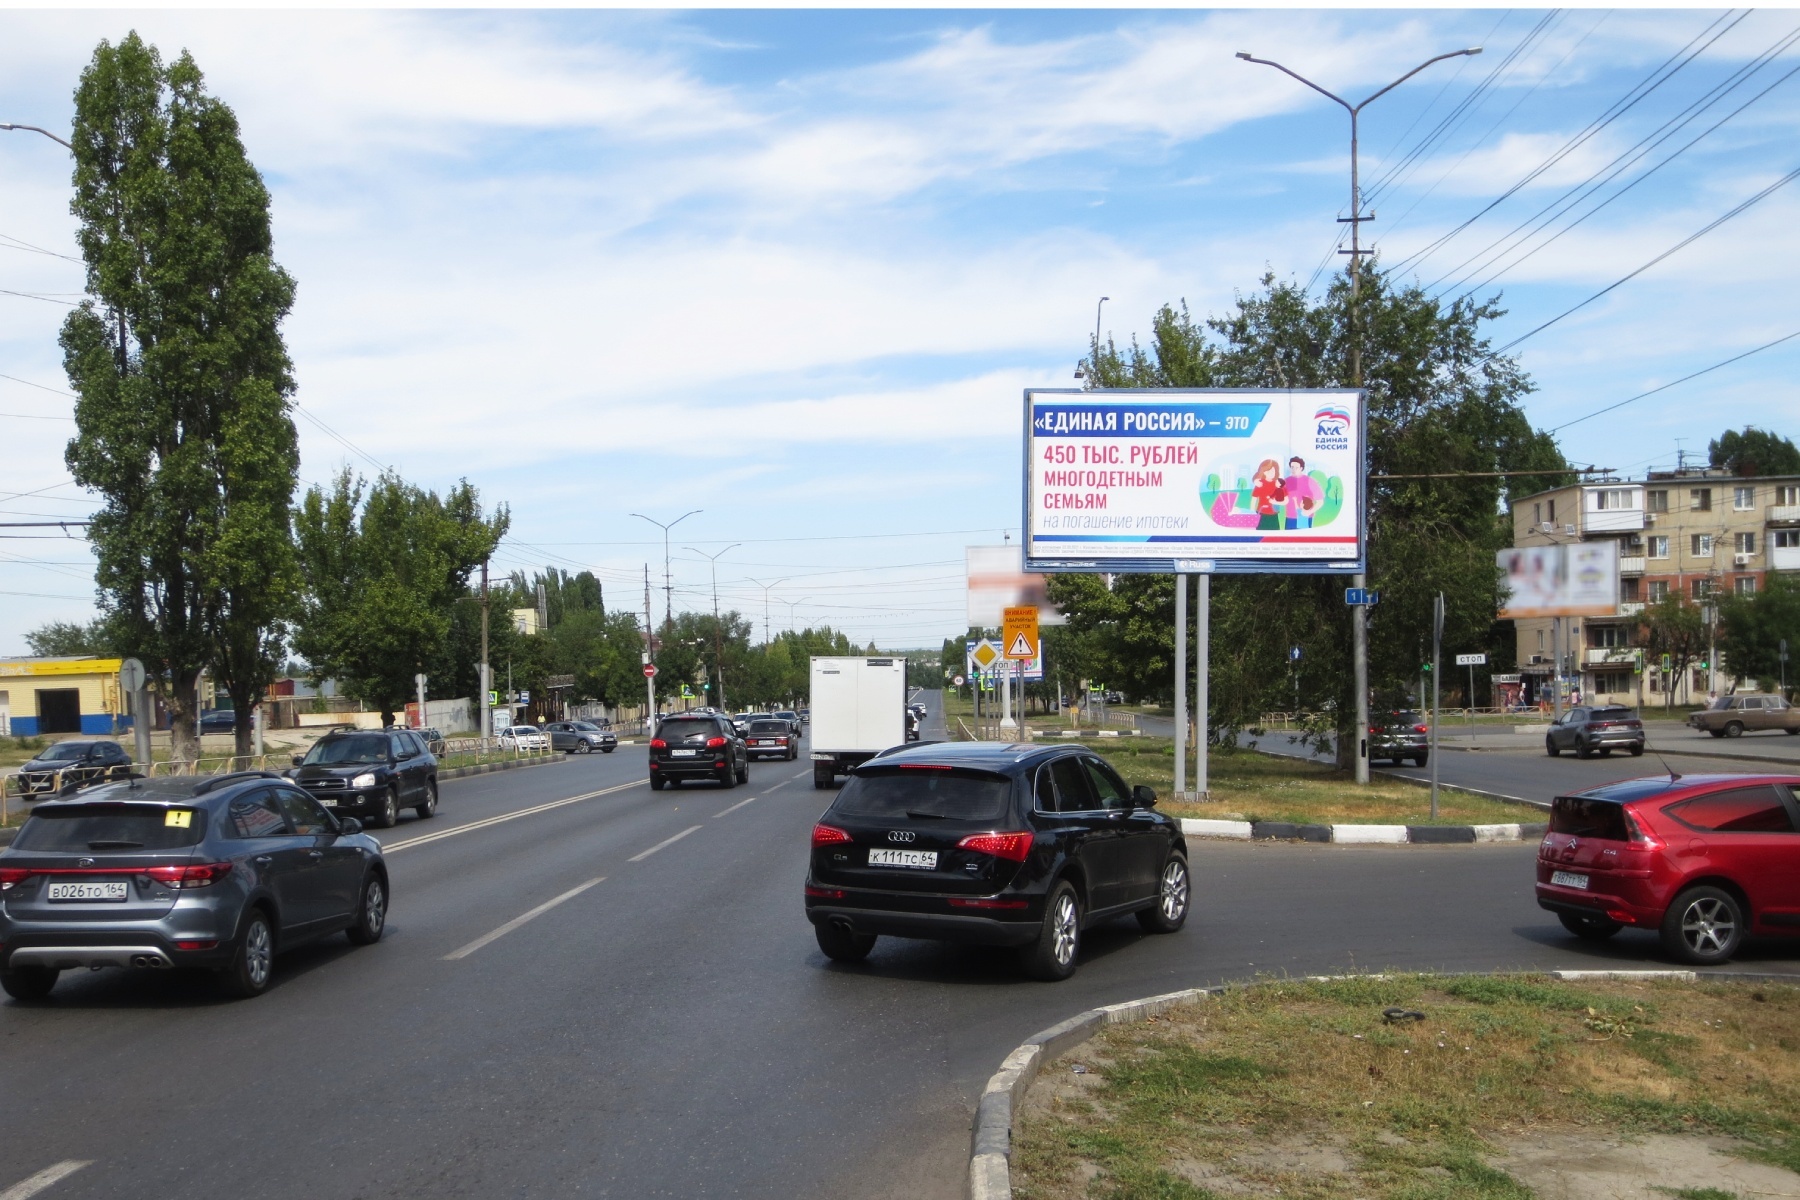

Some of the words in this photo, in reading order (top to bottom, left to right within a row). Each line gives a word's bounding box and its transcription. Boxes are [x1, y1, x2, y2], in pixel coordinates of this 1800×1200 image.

[1034, 412, 1117, 433] «ЕДИНАЯ
[1123, 412, 1206, 431] РОССИЯ»
[1225, 416, 1249, 430] ЭТО
[1043, 445, 1076, 464] 450
[1081, 445, 1124, 464] ТЫС.
[1130, 441, 1198, 467] РУБЛЕЙ
[1044, 470, 1163, 489] МНОГОДЕТНЫМ
[1043, 493, 1107, 509] СЕМЬЯМ
[1043, 515, 1059, 529] на
[1062, 515, 1133, 529] погашение
[1136, 516, 1189, 529] ипотеки
[921, 853, 933, 862] 64
[53, 885, 102, 898] В026ТО
[105, 884, 124, 894] 164
